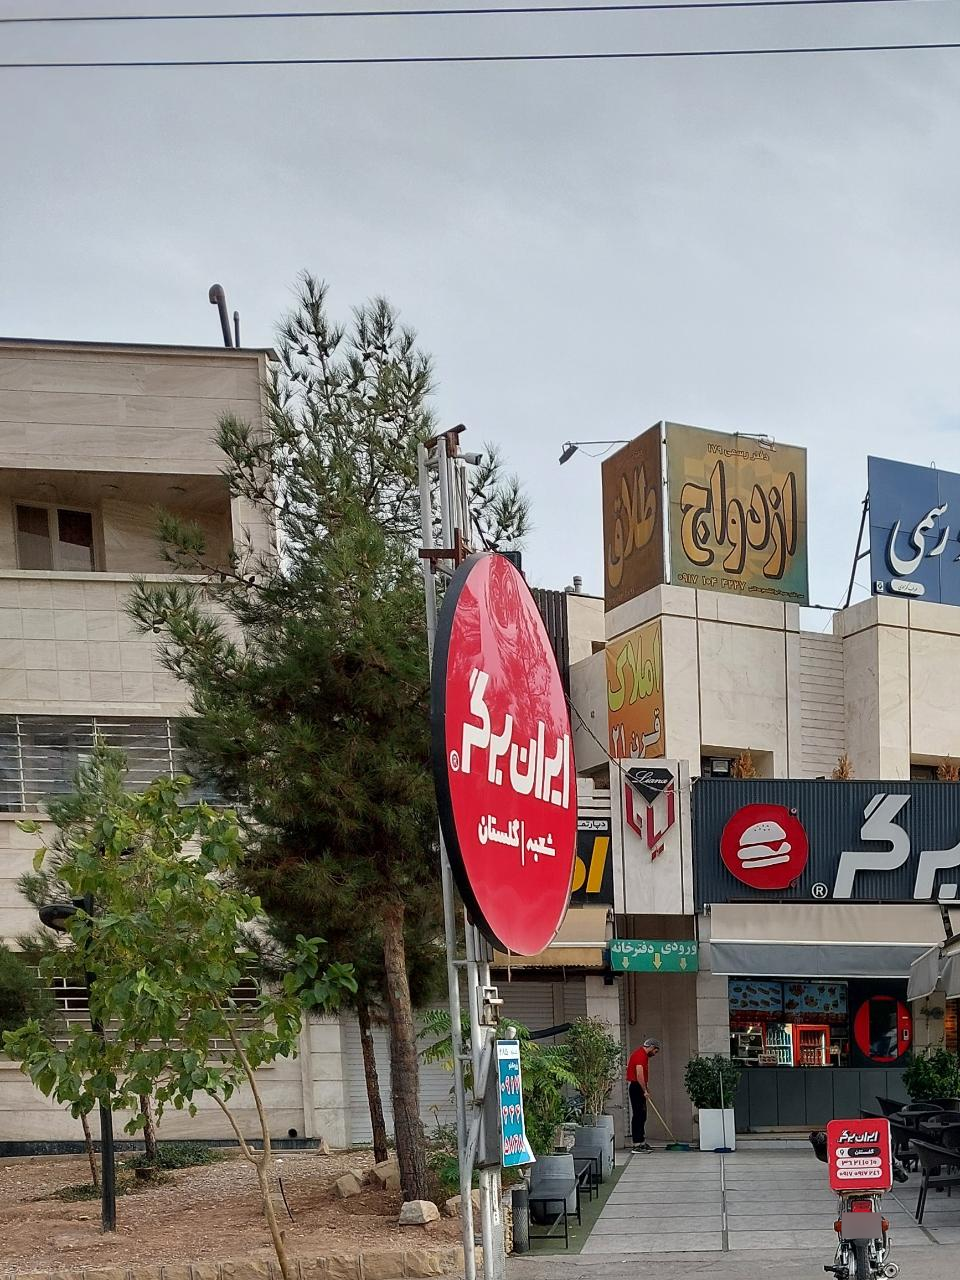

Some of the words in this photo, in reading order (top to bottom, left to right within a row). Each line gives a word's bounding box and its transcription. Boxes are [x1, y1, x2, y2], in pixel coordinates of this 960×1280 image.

[723, 448, 750, 460] رسمی
[607, 463, 657, 590] طلاق
[681, 460, 797, 580] ازدواج
[889, 502, 949, 575] رسمی
[607, 627, 660, 713] املاک
[461, 667, 514, 786] برگر
[612, 722, 626, 759] ۲۱
[629, 707, 661, 759] قرن
[510, 719, 570, 809] ایران
[631, 770, 669, 785] Liana
[478, 814, 520, 848] گلستان
[577, 820, 607, 832] دپارتم
[526, 832, 556, 862] شعبه
[610, 940, 655, 958] دفترخانه
[661, 941, 698, 956] ورودی
[855, 1130, 878, 1142] ایران
